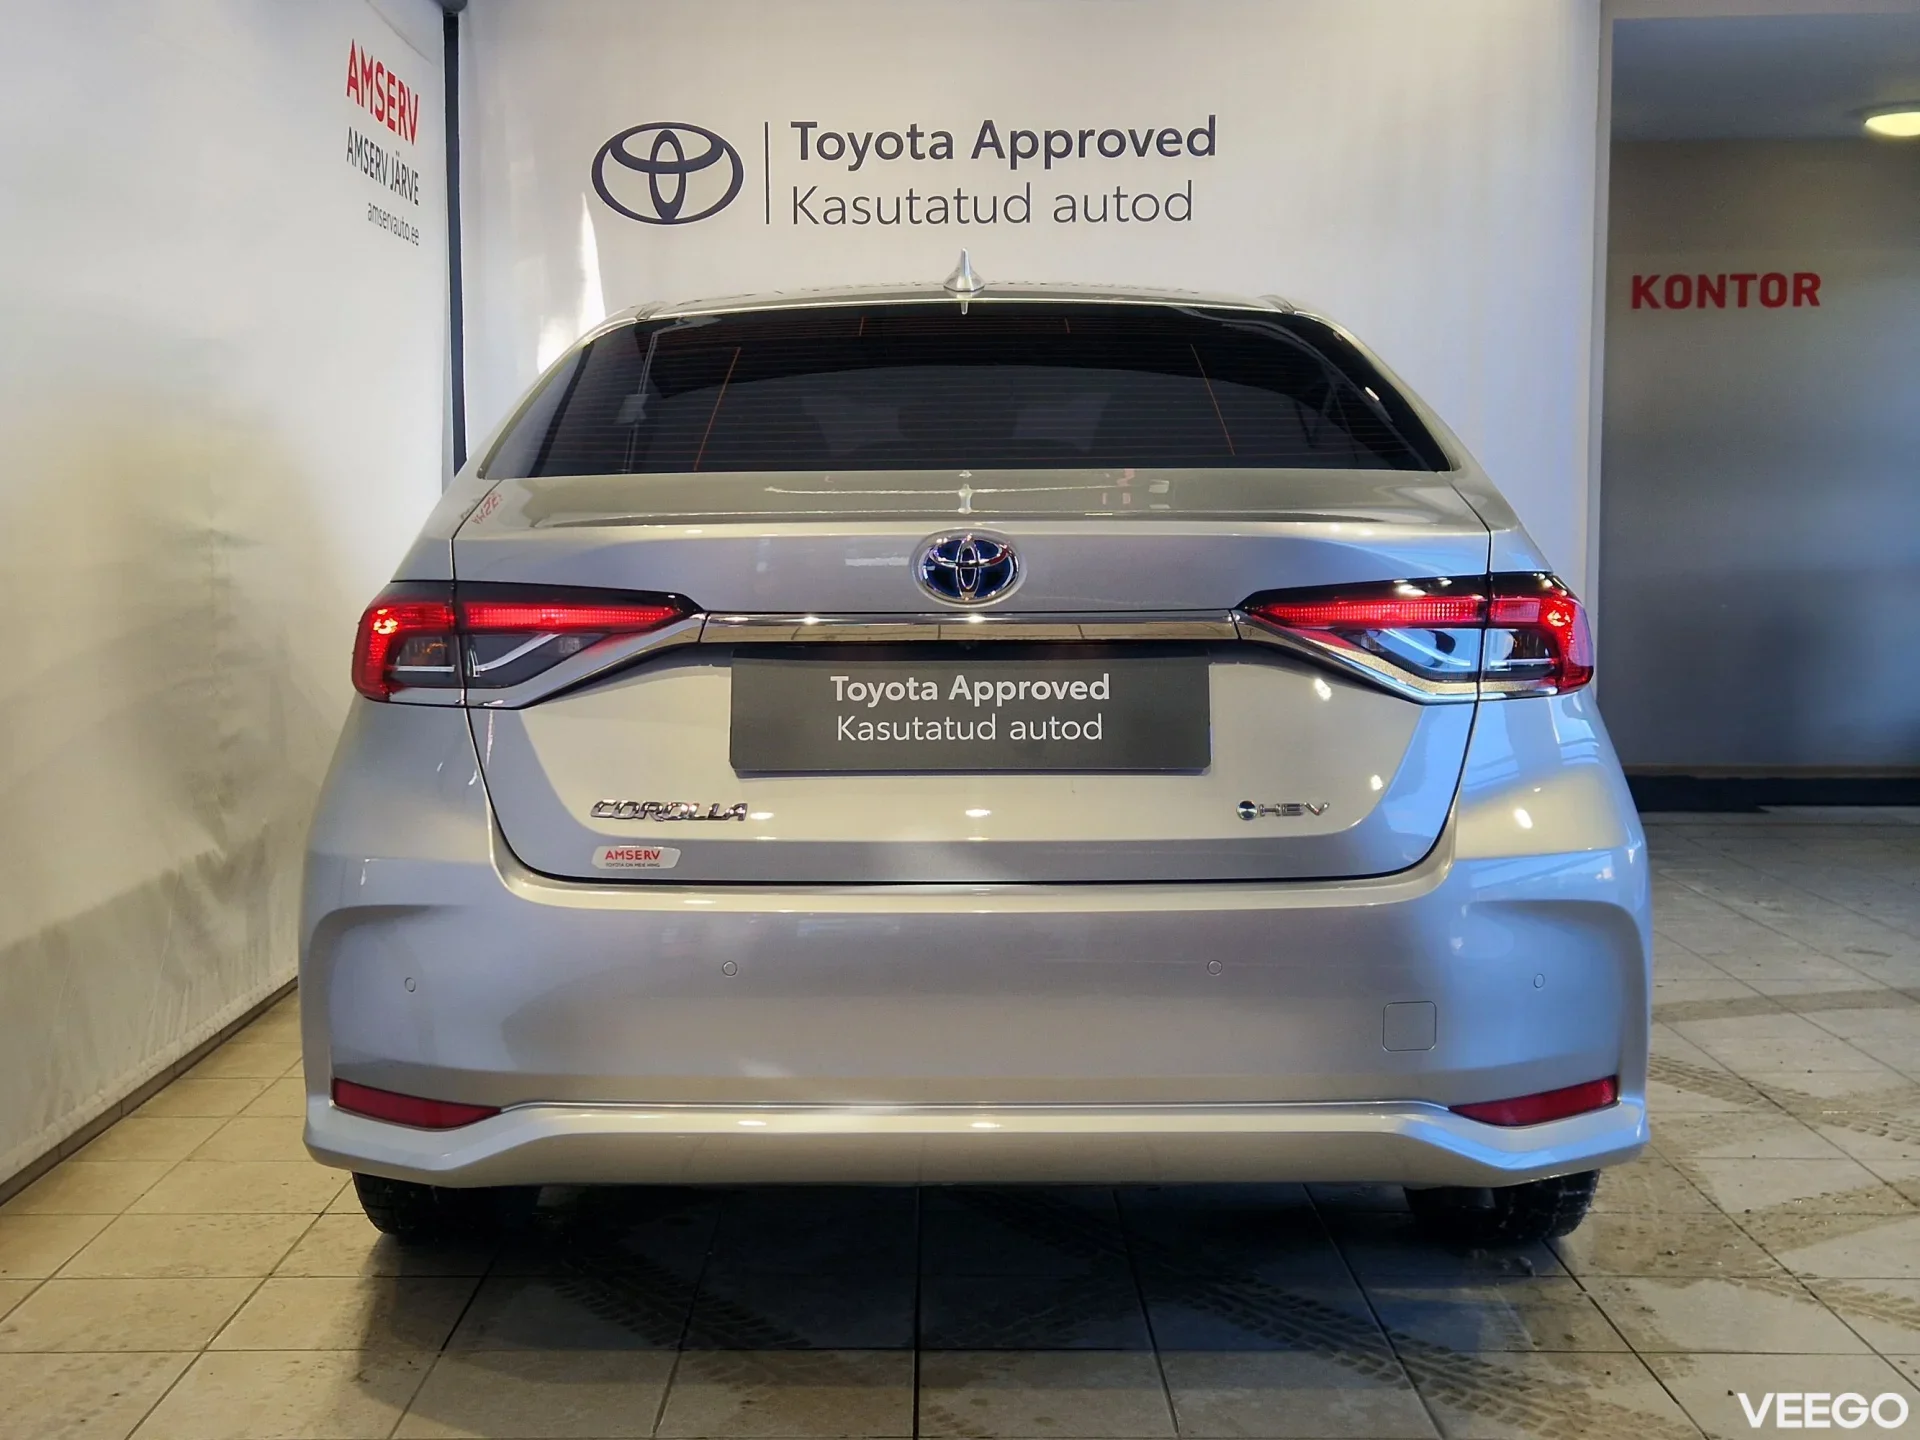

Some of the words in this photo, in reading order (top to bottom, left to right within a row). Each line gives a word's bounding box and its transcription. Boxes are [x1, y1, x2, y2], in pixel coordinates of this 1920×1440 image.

[346, 38, 419, 146] AMSERV
[790, 119, 955, 172] Toyota
[970, 114, 1217, 170] Approved
[346, 126, 388, 187] AMSERV
[389, 150, 420, 206] JÄRVE
[791, 181, 1032, 226] Kasutatud
[1052, 180, 1194, 223] autod
[367, 201, 420, 247] amservauto.ee
[1631, 272, 1822, 310] KONTOR
[830, 675, 939, 708] Toyota
[947, 673, 1111, 707] Approved
[836, 713, 997, 742] Kasutatud
[1008, 713, 1104, 741] autod
[590, 799, 749, 822] COROLLA
[1258, 802, 1331, 817] HEV
[604, 849, 661, 861] AMSERV
